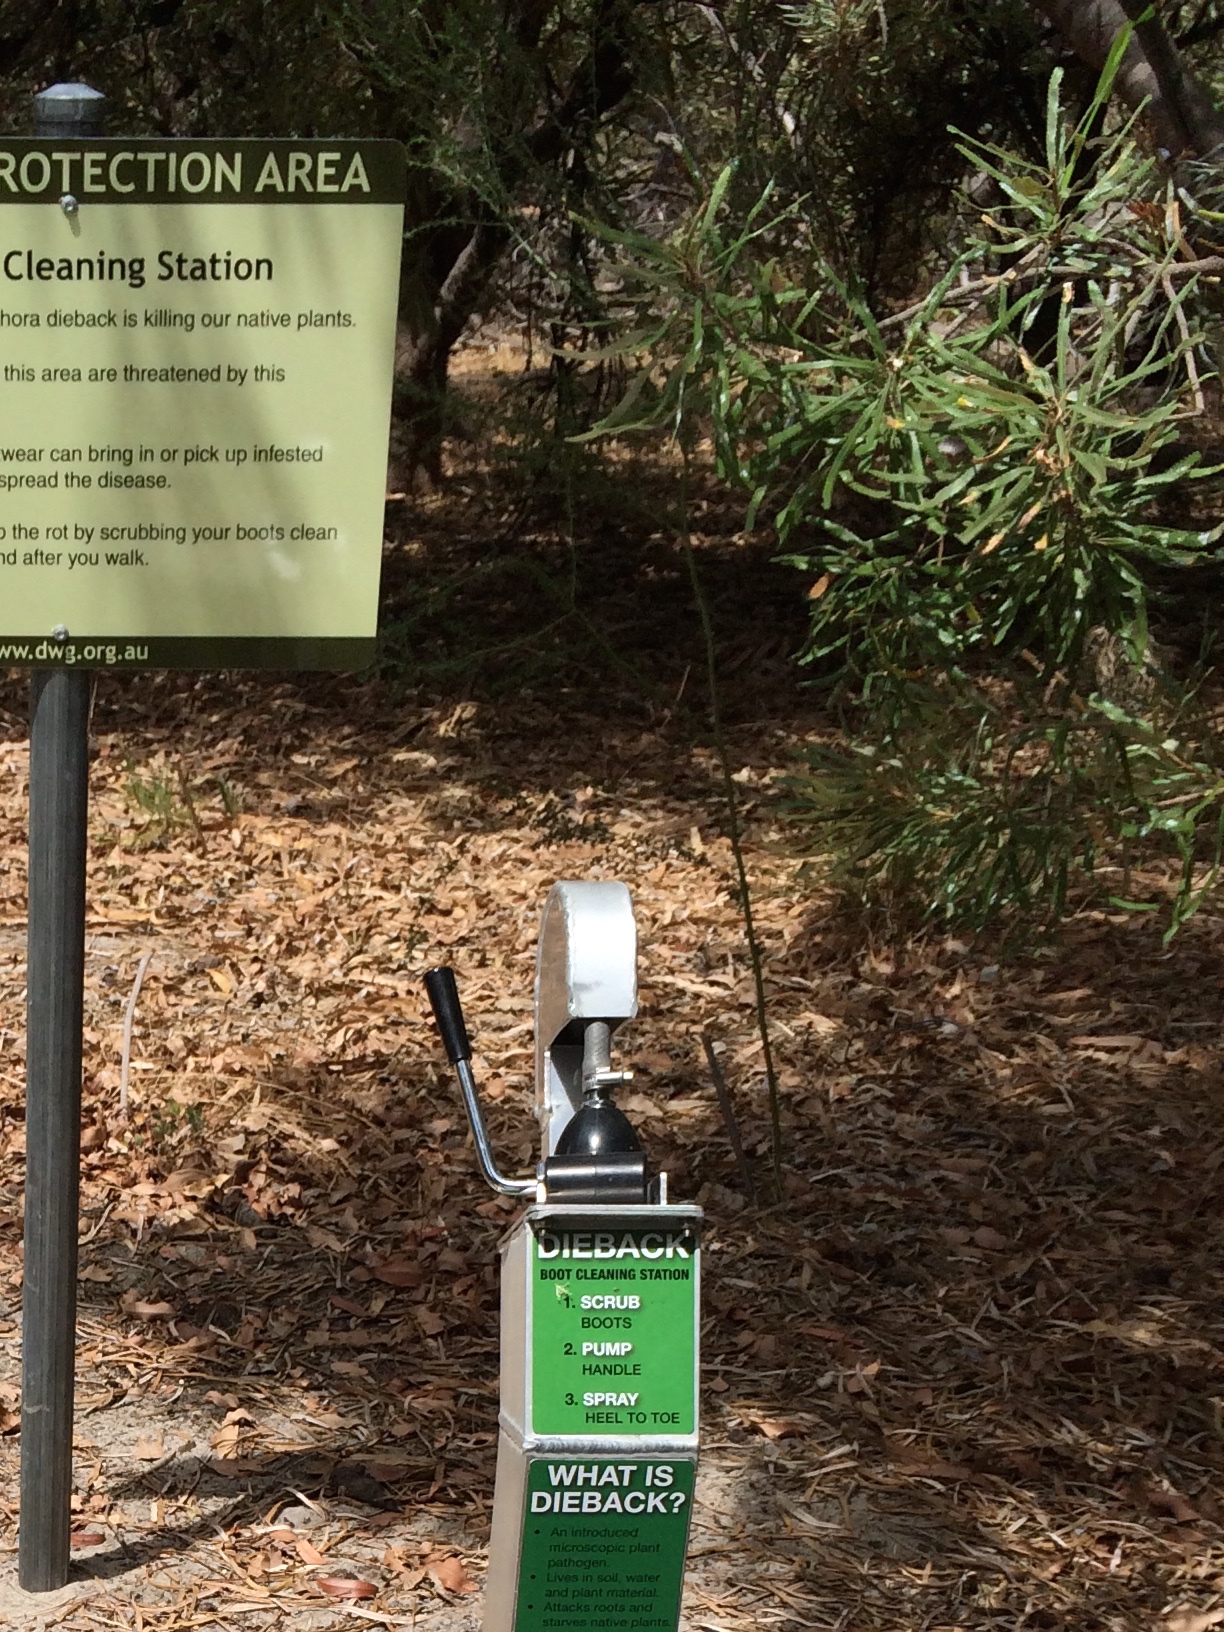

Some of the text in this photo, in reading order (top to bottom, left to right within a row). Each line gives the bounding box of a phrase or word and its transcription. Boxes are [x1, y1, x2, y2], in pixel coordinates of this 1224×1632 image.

[255, 152, 371, 193] AREA
[4, 250, 146, 286] Cleaning
[157, 252, 273, 281] Station
[47, 309, 117, 328] dieback
[123, 309, 137, 328] is
[143, 309, 195, 331] killing
[201, 314, 230, 329] our
[236, 311, 290, 329] native
[297, 309, 356, 332] plants.
[4, 363, 35, 382] this
[41, 368, 82, 383] area
[88, 368, 117, 383] are
[123, 364, 221, 383] threatened
[227, 364, 249, 387] by
[254, 364, 285, 383] this
[50, 448, 82, 462] can
[88, 444, 134, 466] bring
[139, 444, 154, 462] in
[160, 448, 178, 462] or
[184, 444, 220, 467] pick
[226, 449, 247, 467] up
[253, 444, 323, 463] infested
[64, 470, 92, 488] the
[98, 470, 171, 488] disease.
[12, 522, 39, 541] the
[45, 523, 68, 541] rot
[74, 522, 94, 545] by
[99, 522, 186, 545] scrubbing
[191, 527, 230, 545] your
[235, 523, 284, 541] boots
[290, 522, 338, 541] clean
[23, 548, 63, 566] after
[68, 552, 100, 571] you
[105, 548, 149, 566] walk.
[538, 1233, 690, 1259] DIEBACK
[540, 1269, 689, 1280] BOOT CLEANING STATION
[563, 1295, 641, 1309] 1. SCRUB
[581, 1317, 632, 1329] BOOTS
[564, 1343, 632, 1356] 2. PUMP
[582, 1364, 641, 1375] HANDLE
[565, 1393, 639, 1406] 3. SPRAY
[586, 1412, 680, 1424] HEEL TO TOE
[548, 1465, 674, 1486] WHAT IS
[531, 1492, 685, 1513] DIEBACK?
[550, 1528, 638, 1537] An introduced
[549, 1543, 660, 1555] microscopic plant
[548, 1558, 609, 1569] pathogen.
[547, 1573, 661, 1583] Lives in soil, water
[545, 1588, 659, 1599] and plant material.
[544, 1603, 653, 1612] Attacks roots and
[543, 1617, 670, 1628] starves native plants.
